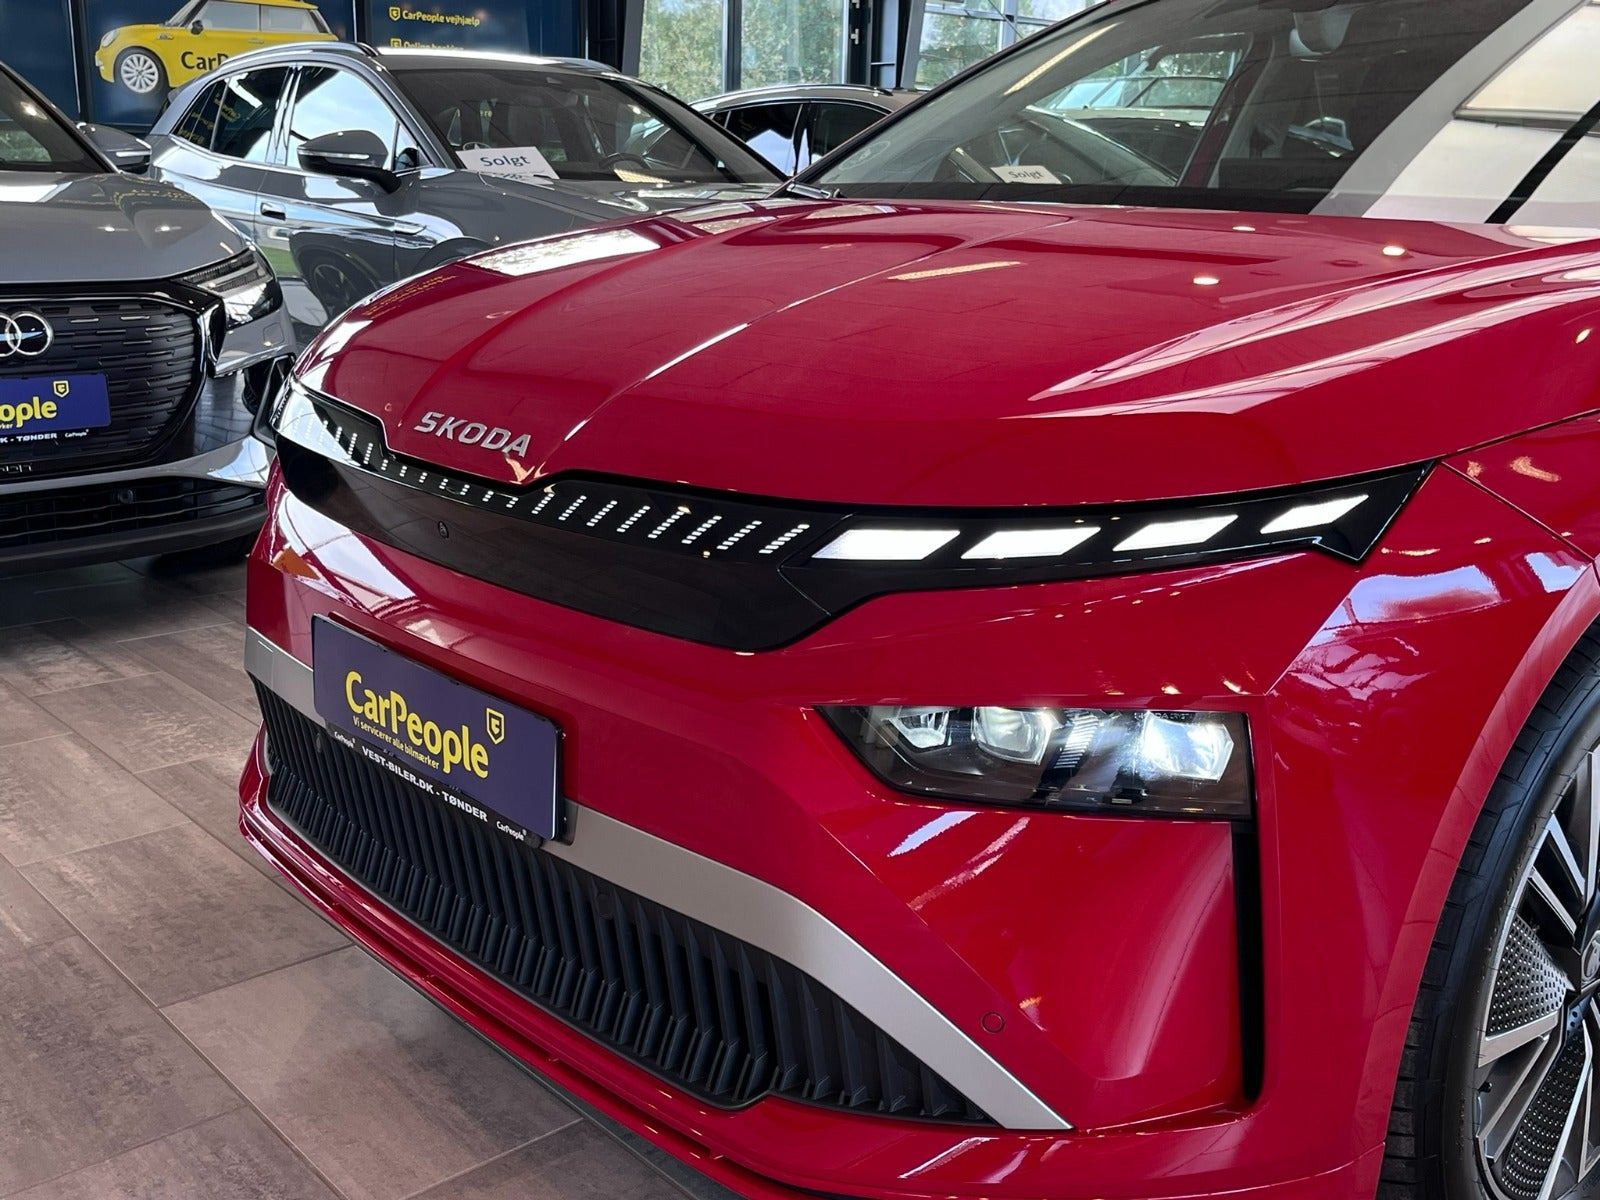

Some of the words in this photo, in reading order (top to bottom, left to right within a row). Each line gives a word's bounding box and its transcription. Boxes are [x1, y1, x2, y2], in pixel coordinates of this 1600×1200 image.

[402, 10, 445, 23] CarPeople
[445, 15, 480, 27] vejhjælp
[480, 155, 530, 167] Solgt
[1008, 170, 1044, 180] Solgt
[0, 396, 57, 428] ople
[16, 433, 57, 442] TØNDER
[413, 411, 531, 458] SKODA
[346, 671, 489, 779] CarPeople
[353, 715, 360, 727] Vi
[361, 721, 392, 743] servicerer
[392, 737, 404, 751] alle
[404, 743, 440, 770] bilmærker
[362, 745, 434, 794] VEST-BILER.DK
[441, 790, 488, 822] TØNDER
